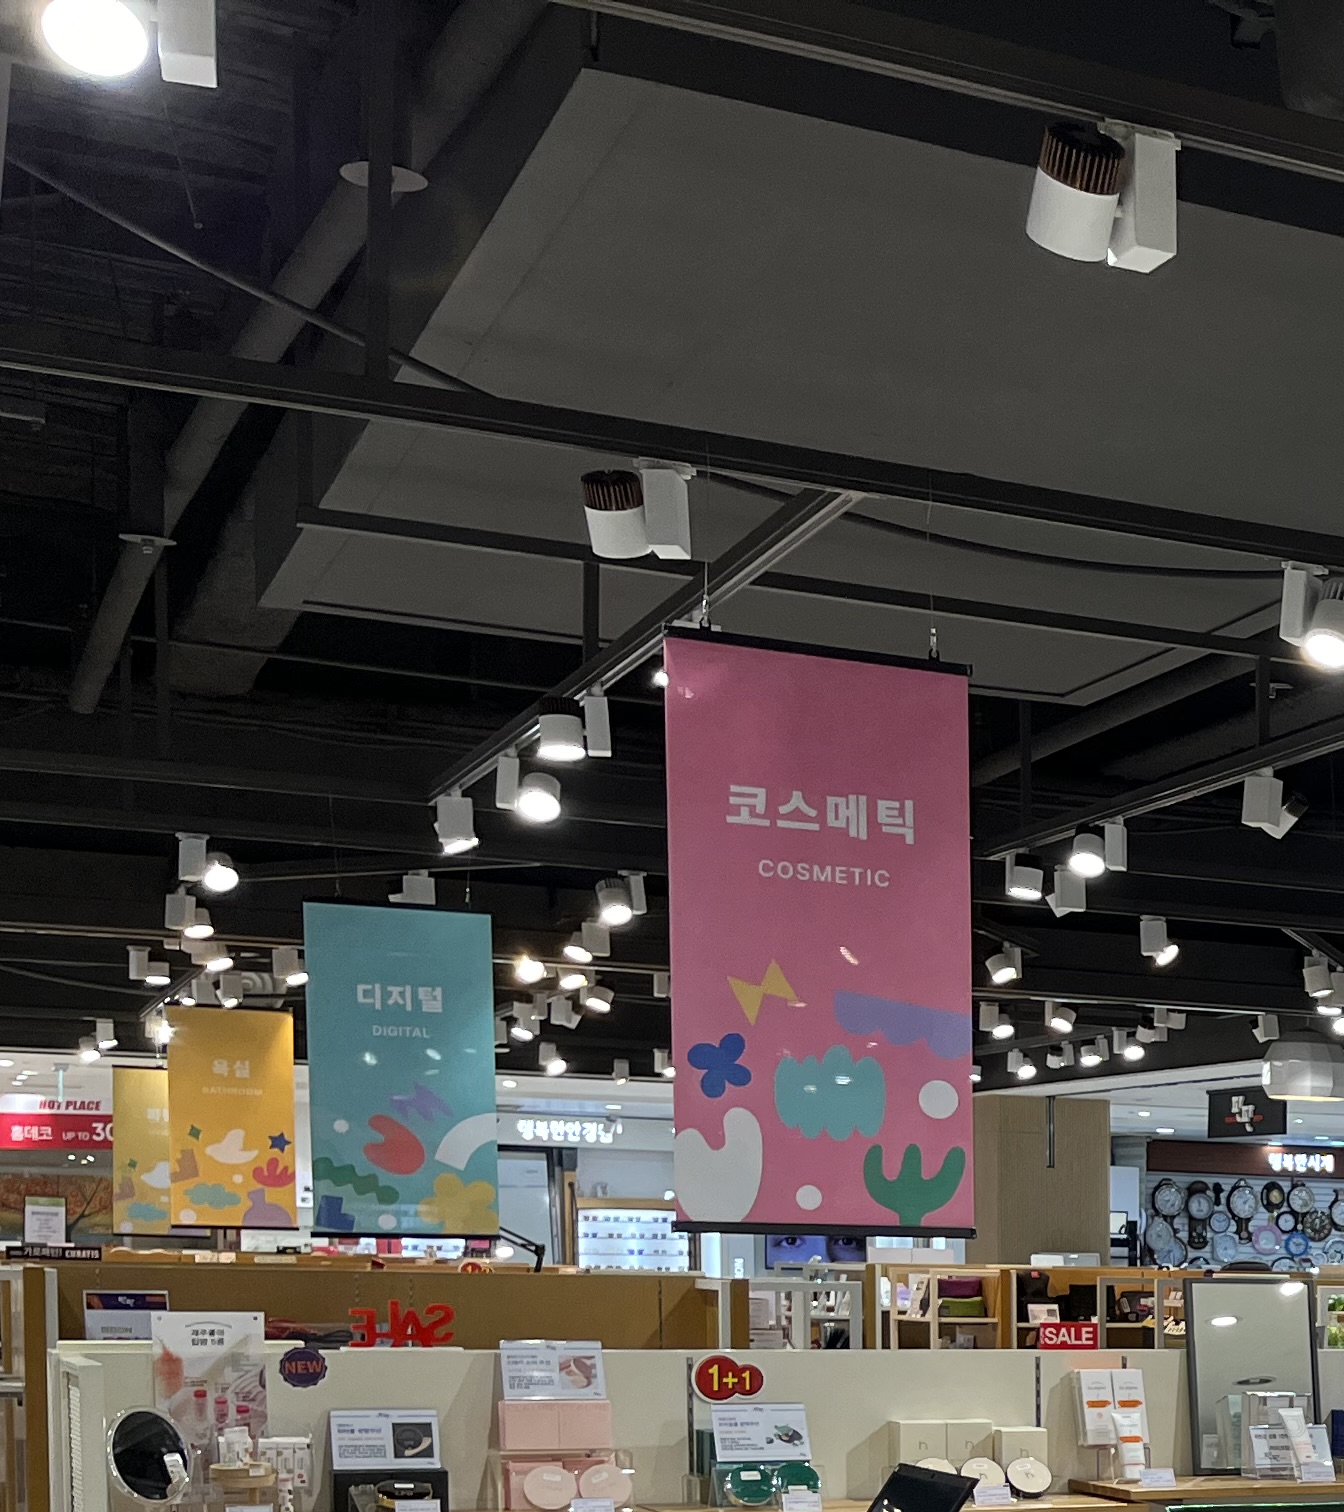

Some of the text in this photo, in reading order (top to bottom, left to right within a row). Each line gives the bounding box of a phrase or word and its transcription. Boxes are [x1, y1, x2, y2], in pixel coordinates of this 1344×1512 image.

[726, 785, 916, 845] 코스메틱
[758, 859, 891, 888] COSMETIC
[356, 983, 444, 1013] 디지털
[372, 1025, 430, 1039] DIGITAL
[211, 1059, 250, 1078] 욕실
[39, 1100, 101, 1111] HOT PLACE
[11, 1124, 53, 1142] 홈데코
[62, 1132, 75, 1141] UP
[77, 1132, 90, 1141] TO
[1044, 1327, 1094, 1345] SALE
[285, 1361, 323, 1374] NEW
[708, 1364, 752, 1392] 1+1
